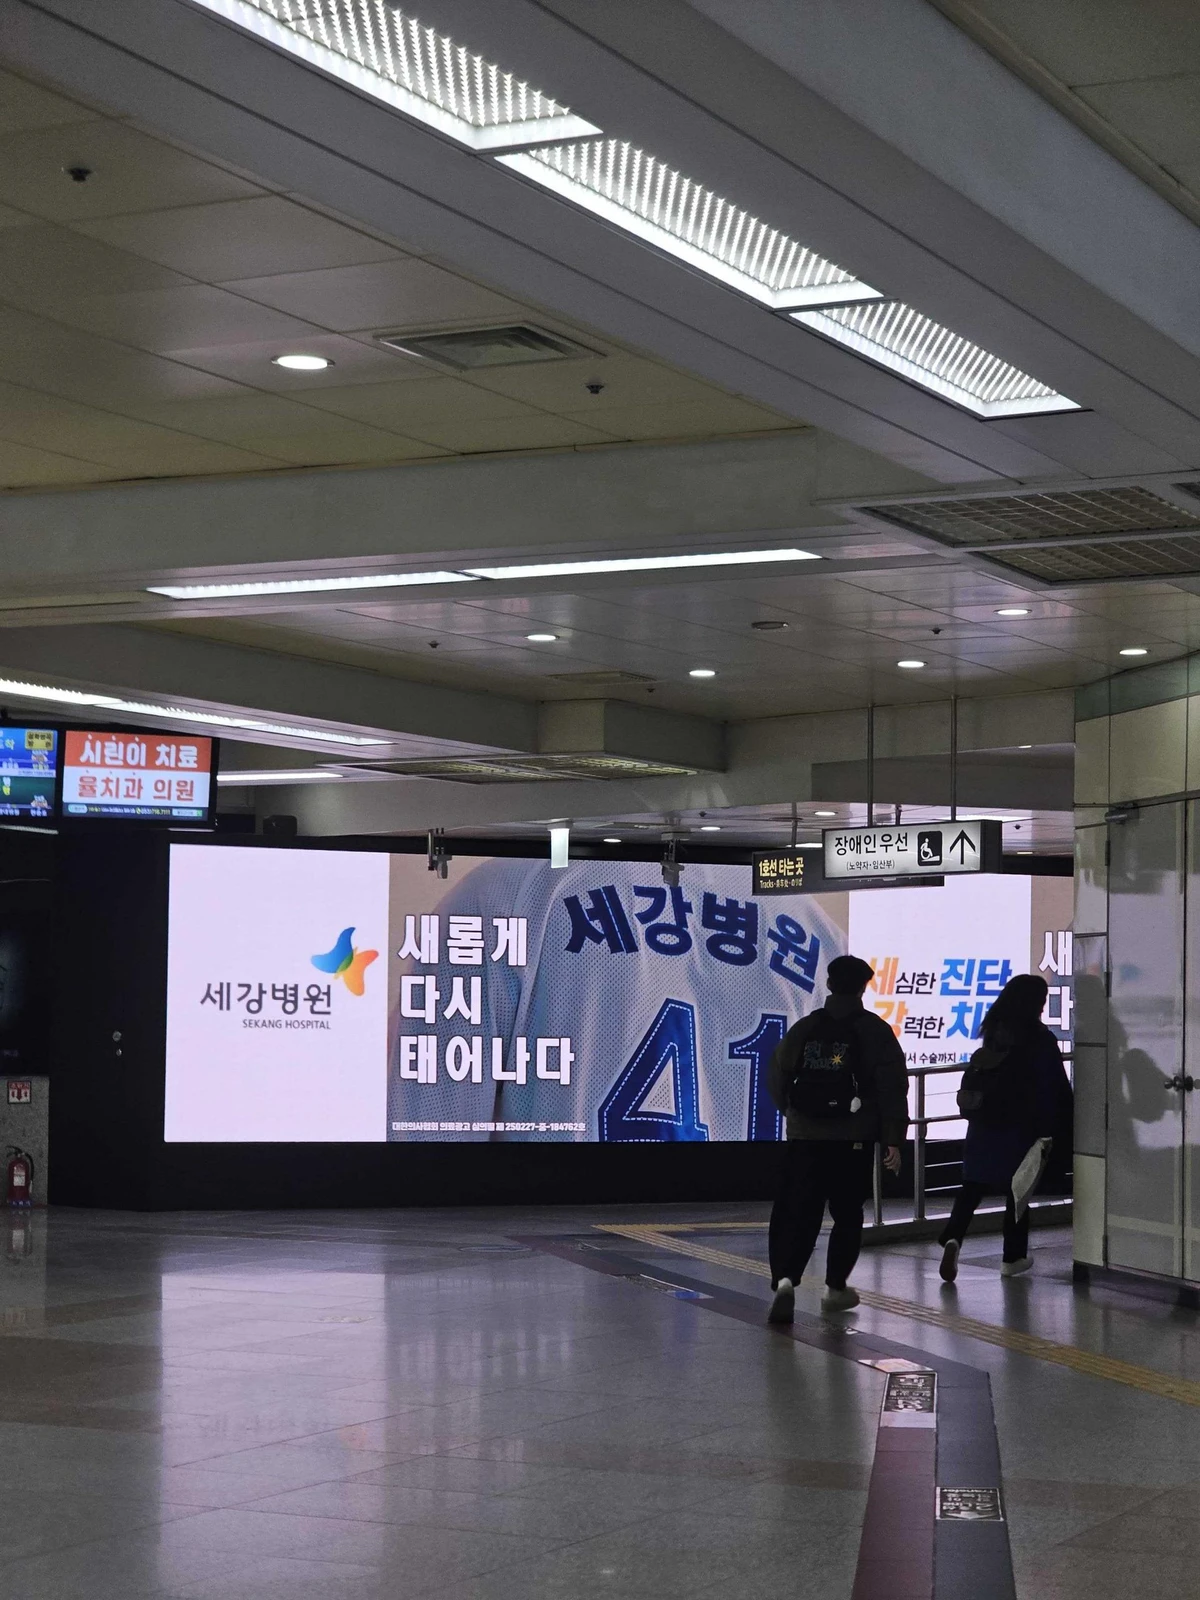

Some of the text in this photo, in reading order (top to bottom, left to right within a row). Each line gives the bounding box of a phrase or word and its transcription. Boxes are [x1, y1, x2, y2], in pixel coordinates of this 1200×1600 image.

[80, 734, 147, 767] 시린이
[155, 744, 199, 768] 치료
[152, 780, 195, 802] 의원
[398, 914, 528, 967] 새롭게
[563, 884, 821, 995] 세강병원
[939, 957, 1012, 997] 진단
[200, 981, 332, 1015] 세강병원
[400, 975, 482, 1025] 다시
[242, 1018, 332, 1030] SEKANG HOSPITAL
[399, 1035, 575, 1085] 태어나다
[597, 997, 787, 1142] 41
[919, 1052, 957, 1064] 수술까지
